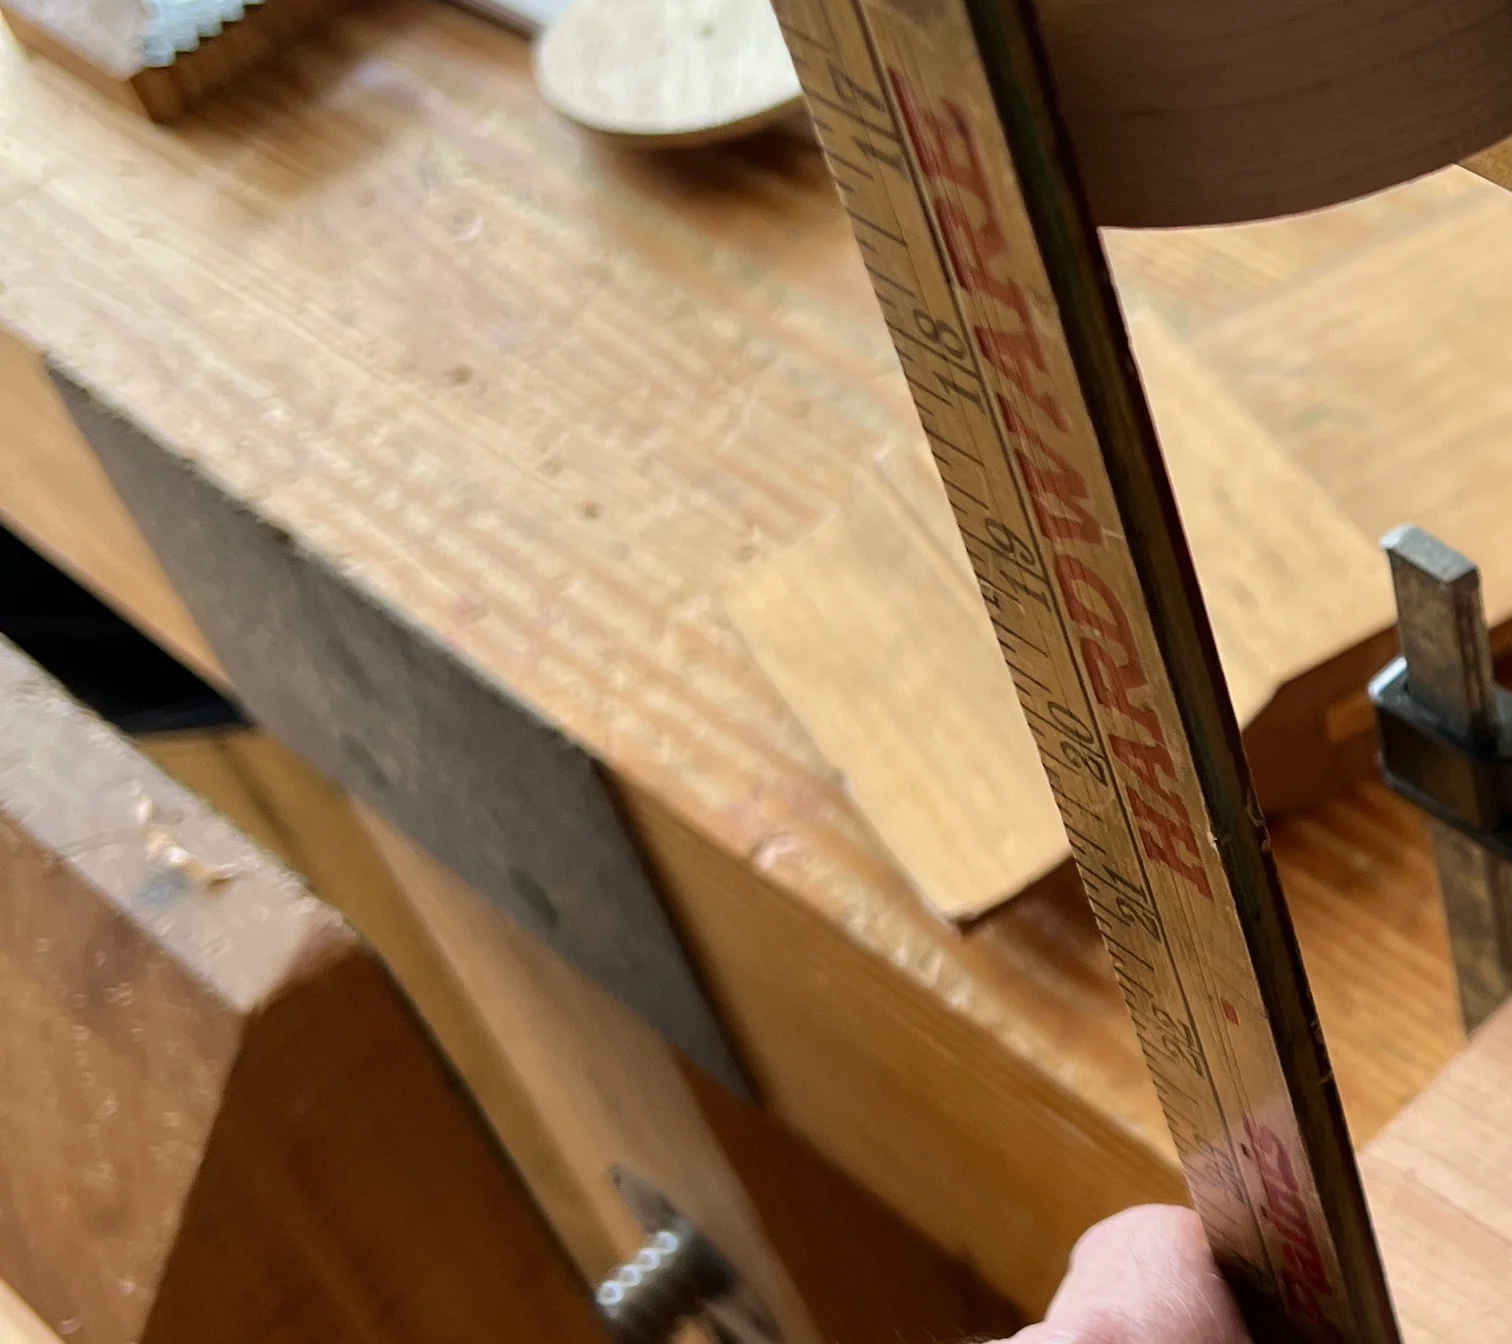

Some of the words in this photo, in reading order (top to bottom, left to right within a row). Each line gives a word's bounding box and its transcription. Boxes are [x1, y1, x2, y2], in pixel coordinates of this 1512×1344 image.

[828, 61, 911, 180] 17
[915, 310, 987, 416] 18
[888, 66, 1214, 901] HARDWARE
[984, 515, 1054, 615] 19
[1045, 698, 1109, 786] 20
[1105, 871, 1161, 943] 21
[1149, 1004, 1207, 1078] 22
